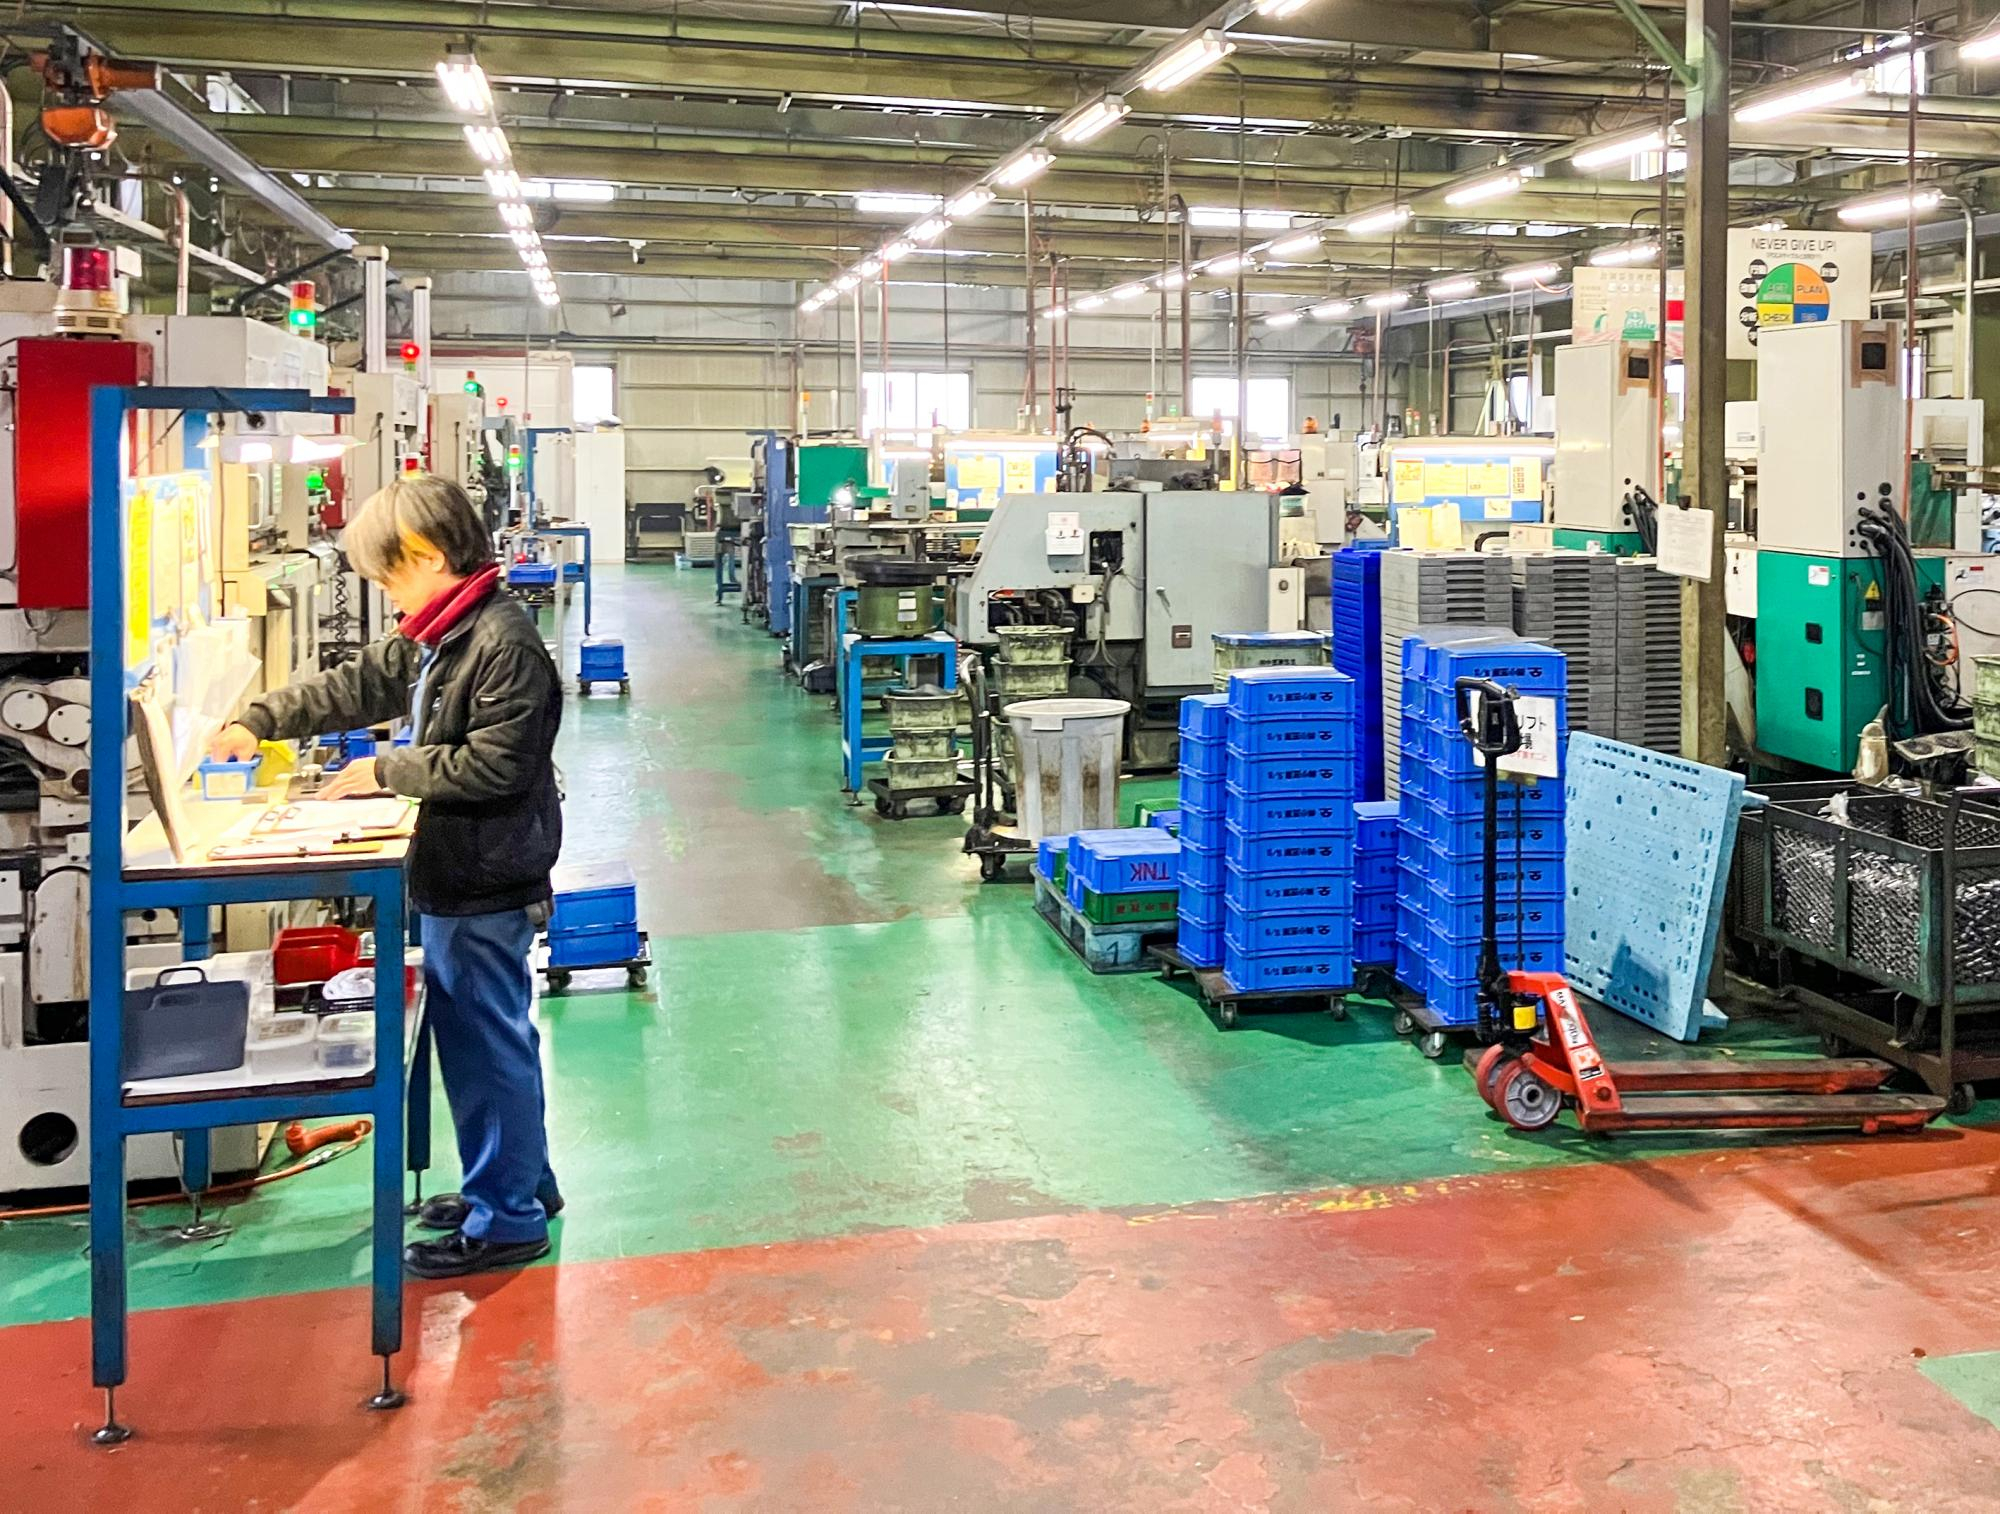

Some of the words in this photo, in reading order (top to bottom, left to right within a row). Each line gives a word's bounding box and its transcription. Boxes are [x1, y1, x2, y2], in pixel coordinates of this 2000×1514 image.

[1751, 238, 1788, 250] NEVER
[1791, 239, 1816, 251] GIVE
[1818, 240, 1837, 252] UP!
[1796, 284, 1823, 294] PLAN
[1762, 313, 1790, 322] CHECK
[1129, 861, 1171, 882] TNK
